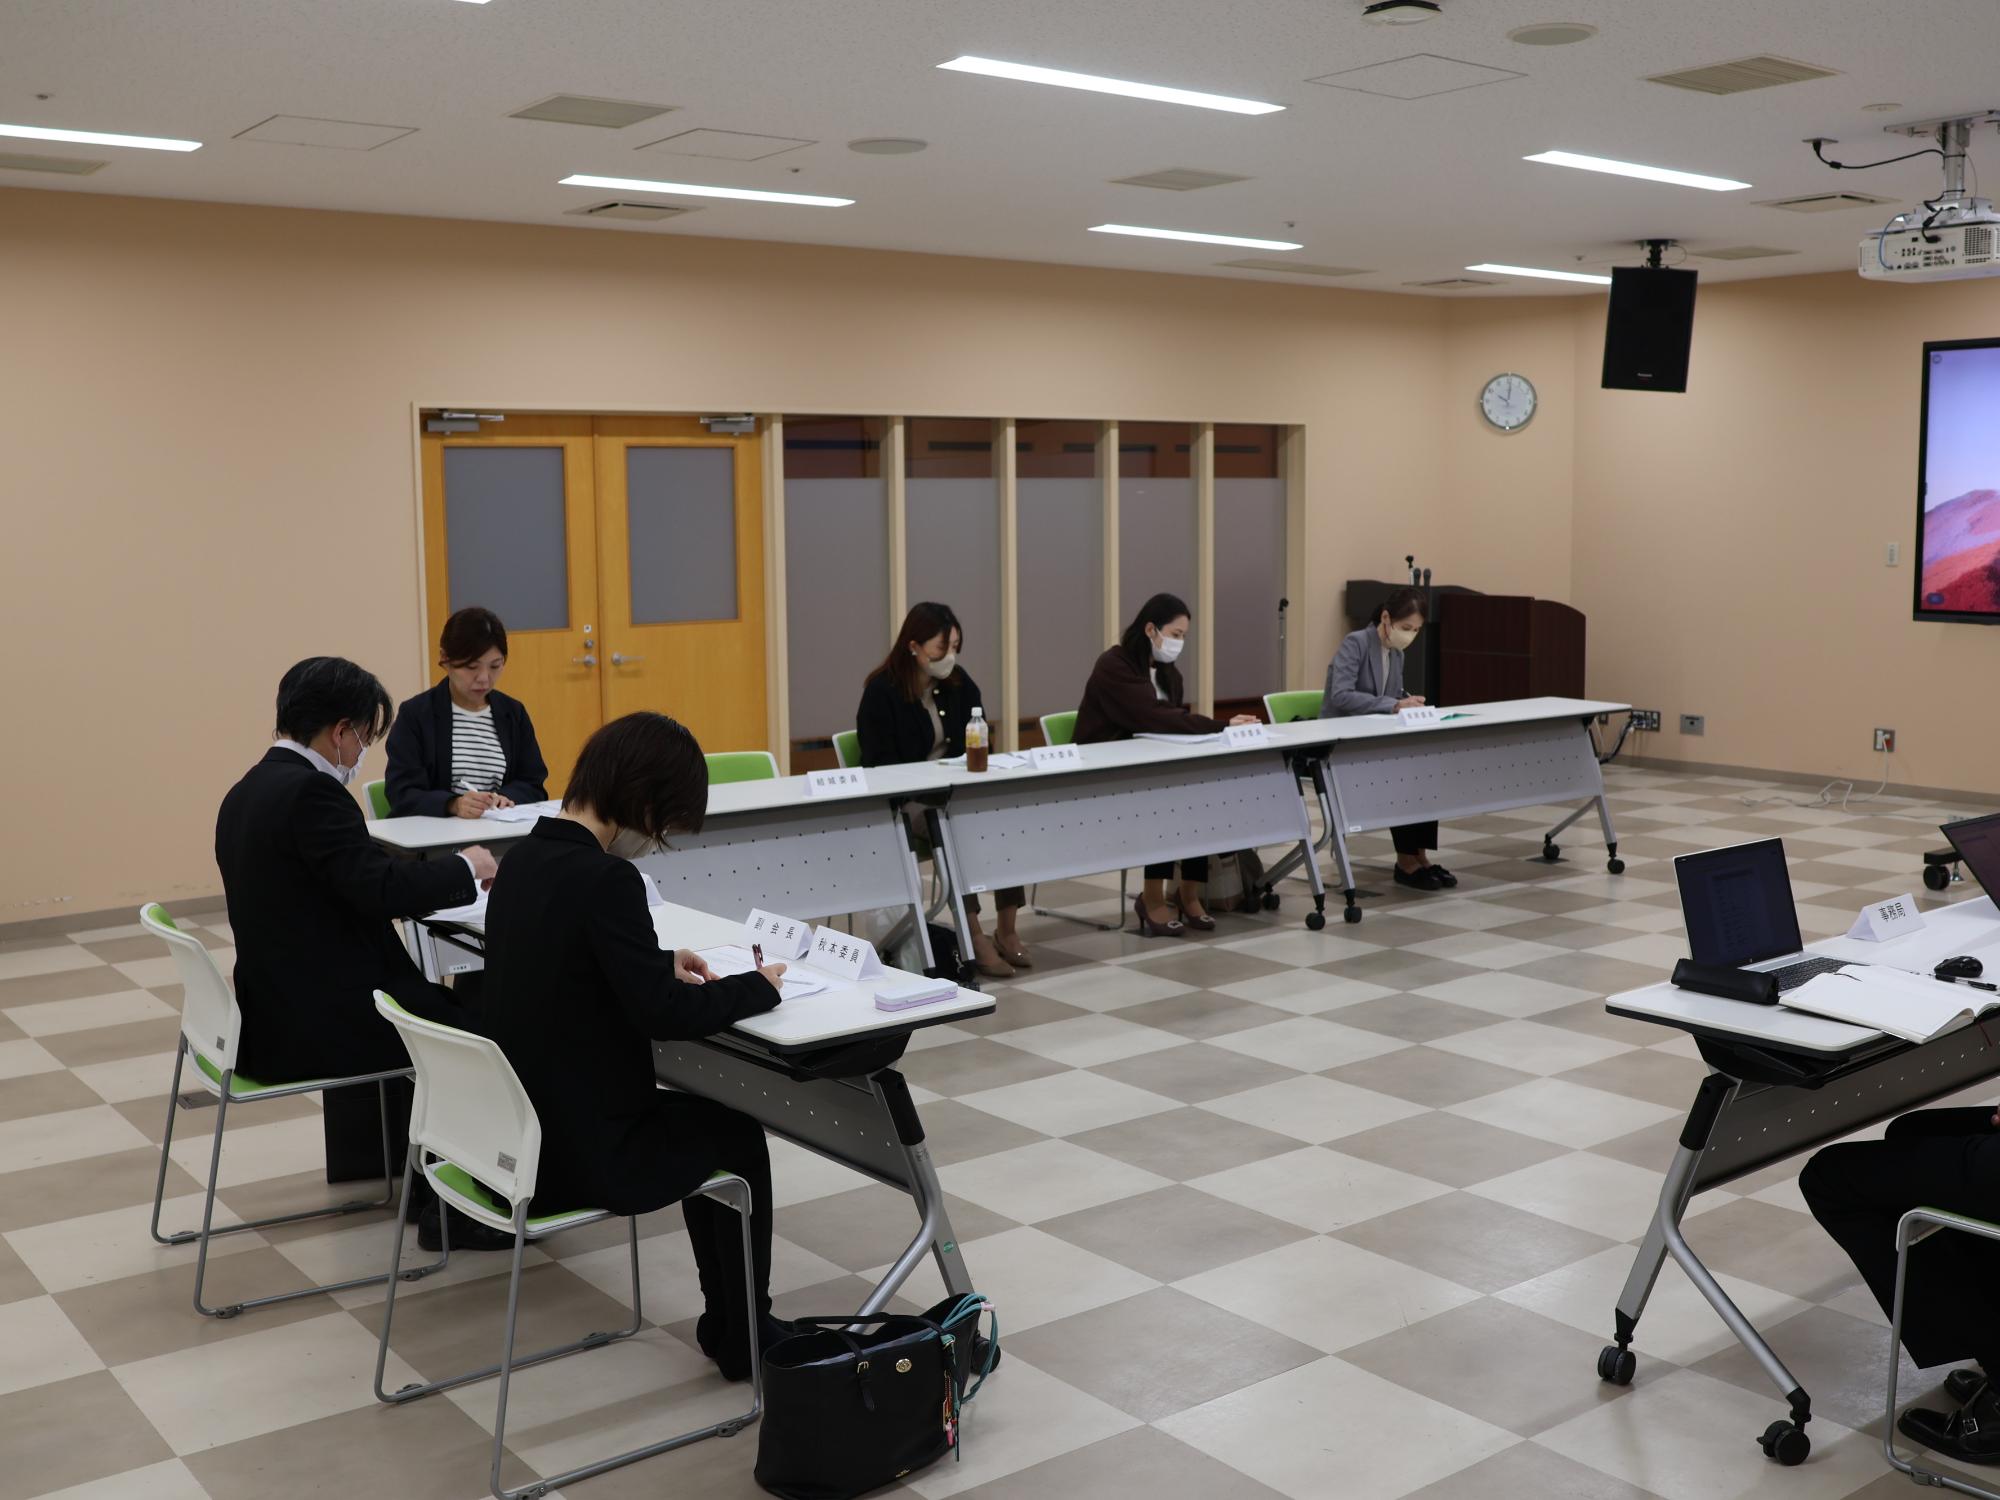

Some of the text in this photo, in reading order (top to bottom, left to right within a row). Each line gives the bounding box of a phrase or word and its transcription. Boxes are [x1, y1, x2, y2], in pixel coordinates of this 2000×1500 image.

[1878, 902, 1906, 923] 事務局
[754, 916, 795, 940] 副会長
